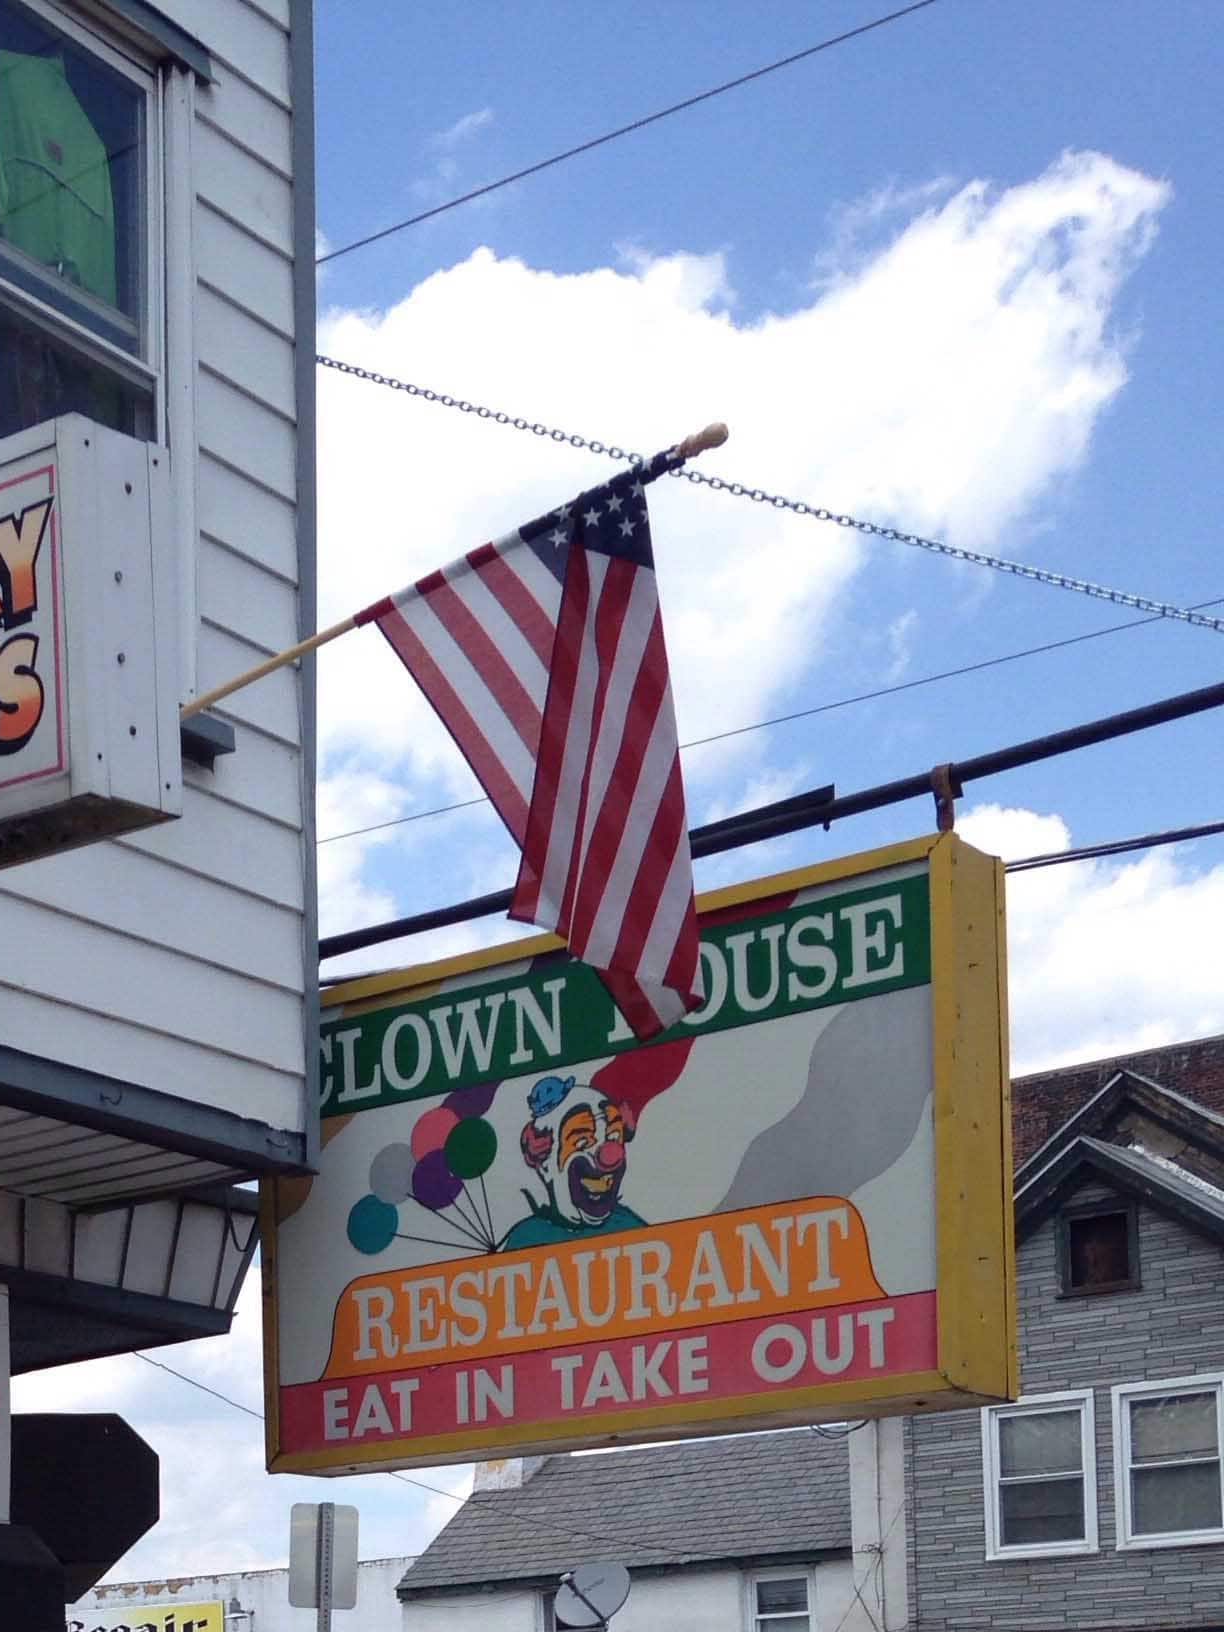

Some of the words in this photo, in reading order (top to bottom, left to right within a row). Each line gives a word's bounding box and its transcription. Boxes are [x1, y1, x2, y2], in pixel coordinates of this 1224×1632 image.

[608, 894, 904, 1043] OUSE
[352, 1207, 849, 1361] RESTAURANT
[322, 1378, 420, 1441] EAT
[455, 1364, 514, 1424] IN
[551, 1336, 708, 1410] TAKE
[750, 1307, 895, 1384] OUT
